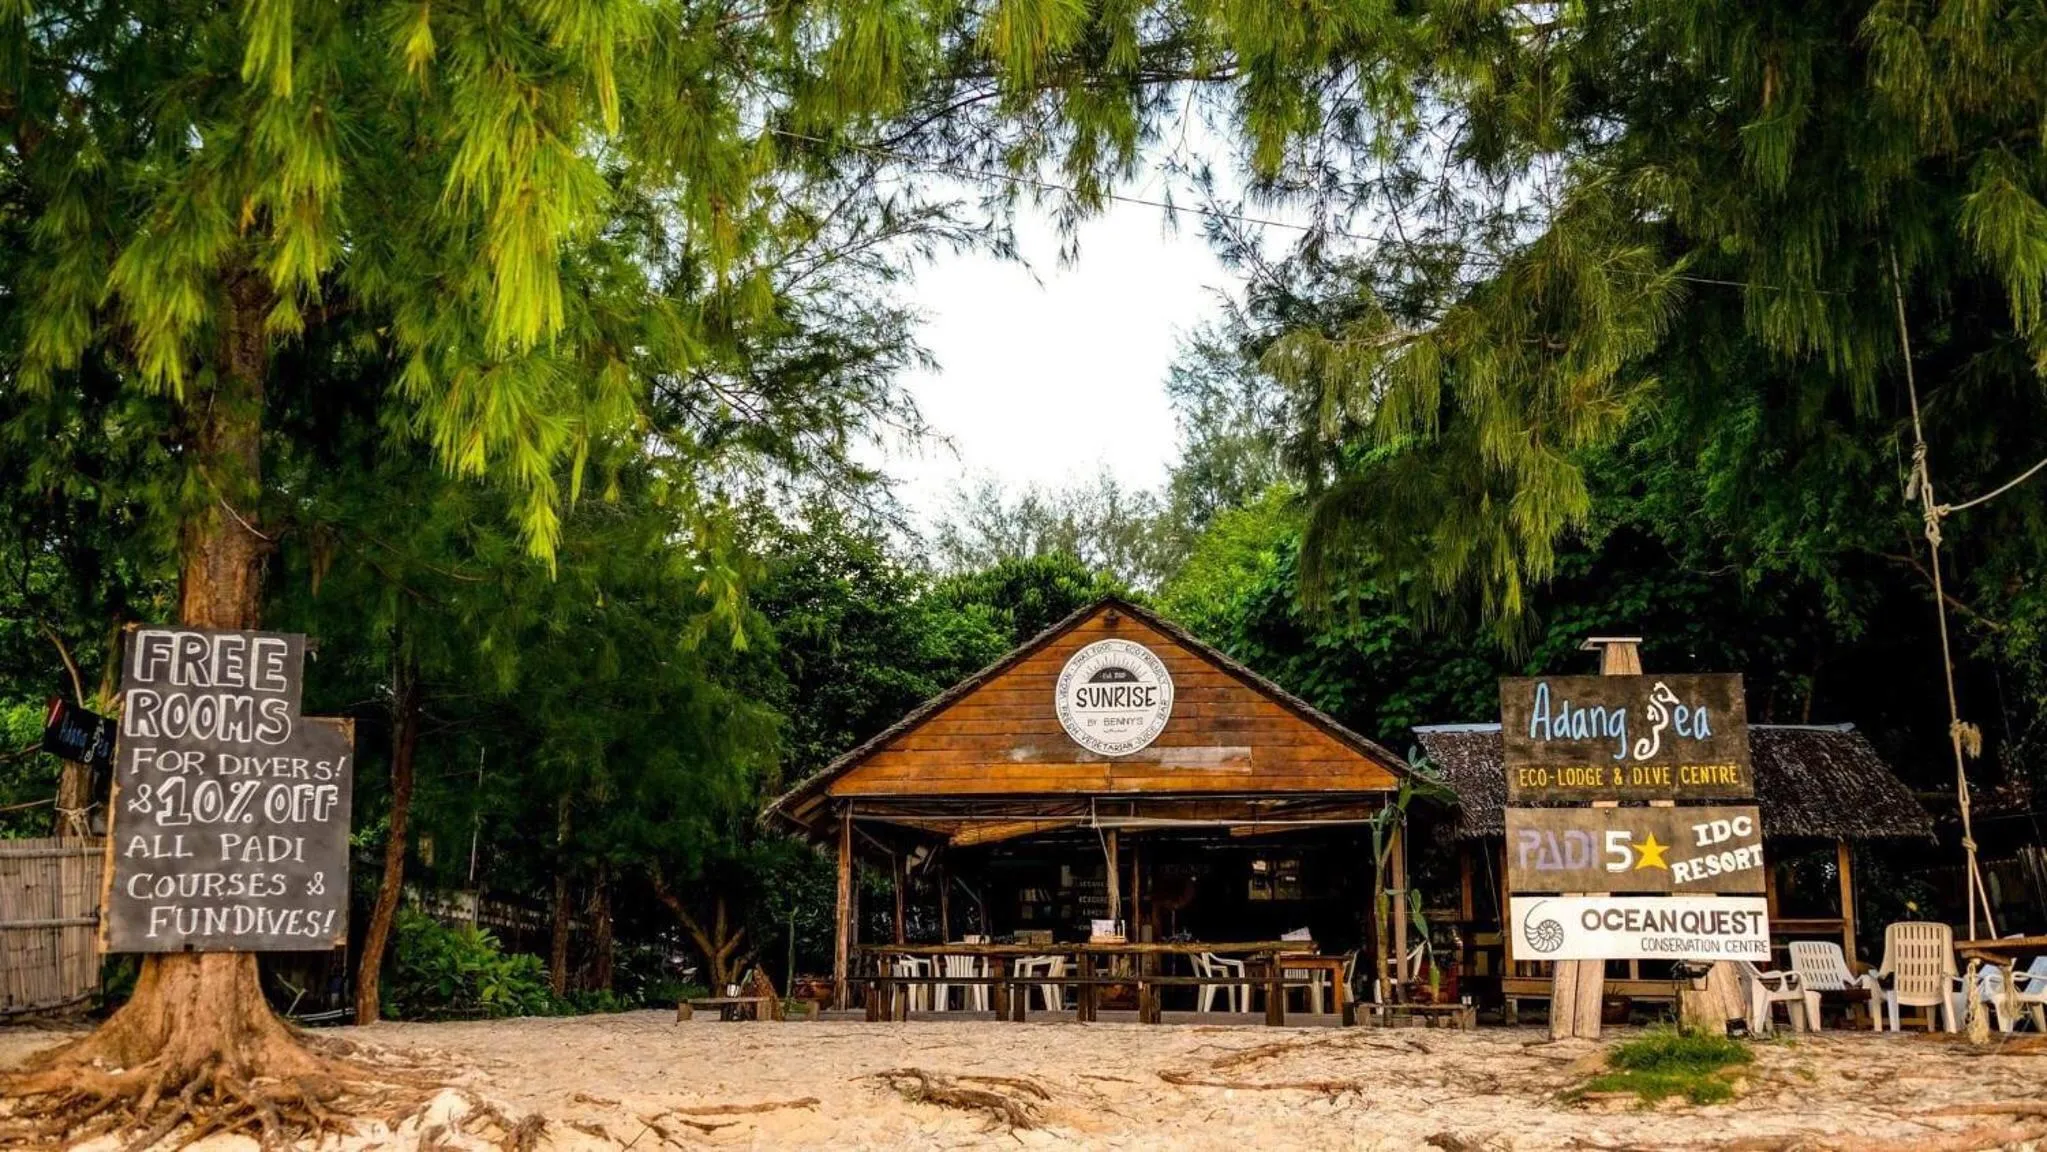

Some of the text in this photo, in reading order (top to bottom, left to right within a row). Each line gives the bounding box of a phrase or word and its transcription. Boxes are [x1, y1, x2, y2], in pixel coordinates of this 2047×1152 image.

[134, 630, 289, 693] FREE
[1076, 686, 1158, 708] SUNRISE
[125, 689, 292, 745] ROOMS
[1530, 682, 1628, 760] Adang
[130, 748, 346, 781] FOR DIVERS!
[1519, 763, 1739, 787] ECO-LODGE & DIVE CENTRE
[264, 784, 338, 824] OFF
[124, 833, 305, 863] ALL PADI
[1692, 816, 1753, 847] IDC
[1517, 827, 1634, 873] PADI 5
[1671, 844, 1764, 884] RESORT
[127, 871, 325, 900] COURSES &
[1641, 937, 1768, 954] CONSERVATION CENTRE
